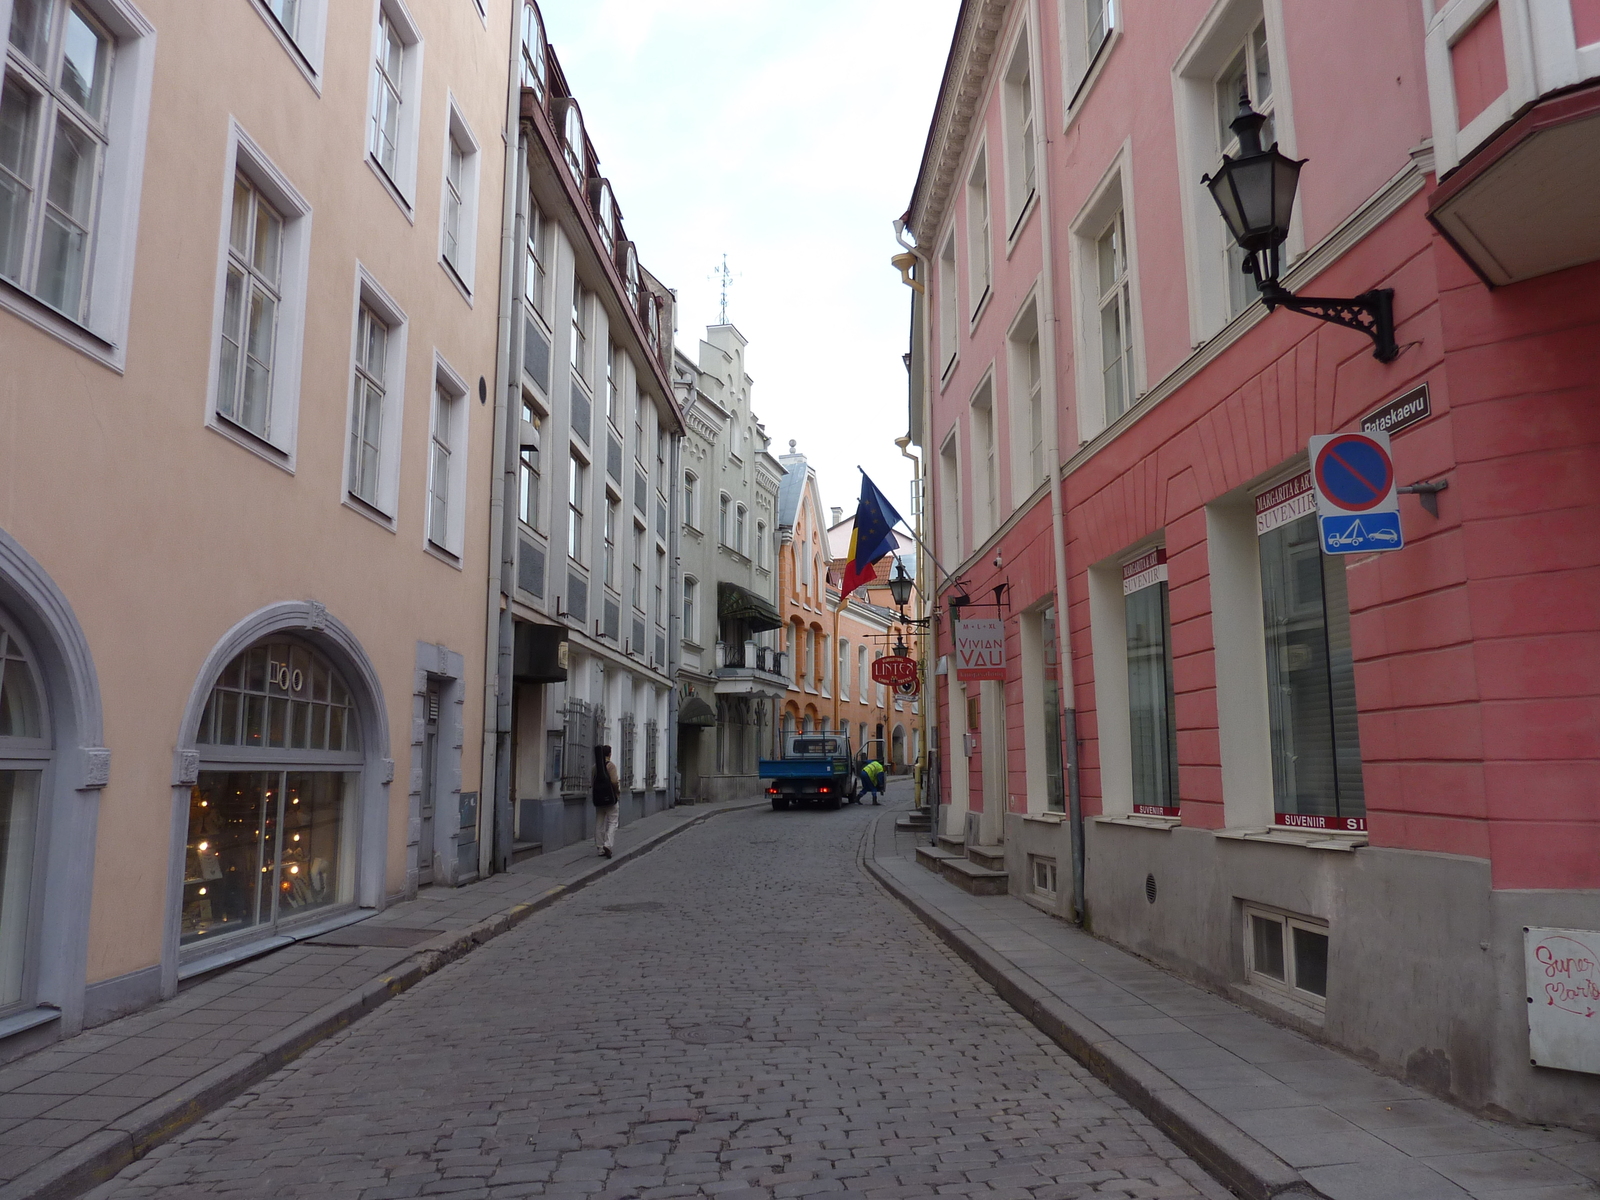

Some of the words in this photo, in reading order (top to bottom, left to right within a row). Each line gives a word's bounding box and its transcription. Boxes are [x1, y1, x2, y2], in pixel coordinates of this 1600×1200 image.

[1256, 482, 1294, 513] MARGARITA
[1257, 492, 1316, 532] SUVENIIR
[1124, 567, 1159, 594] SUVENIIR
[958, 638, 1003, 649] VIVIAN
[959, 649, 1003, 667] VAU
[1139, 805, 1164, 816] SUVENIIR
[1285, 814, 1326, 828] SUVENIIR
